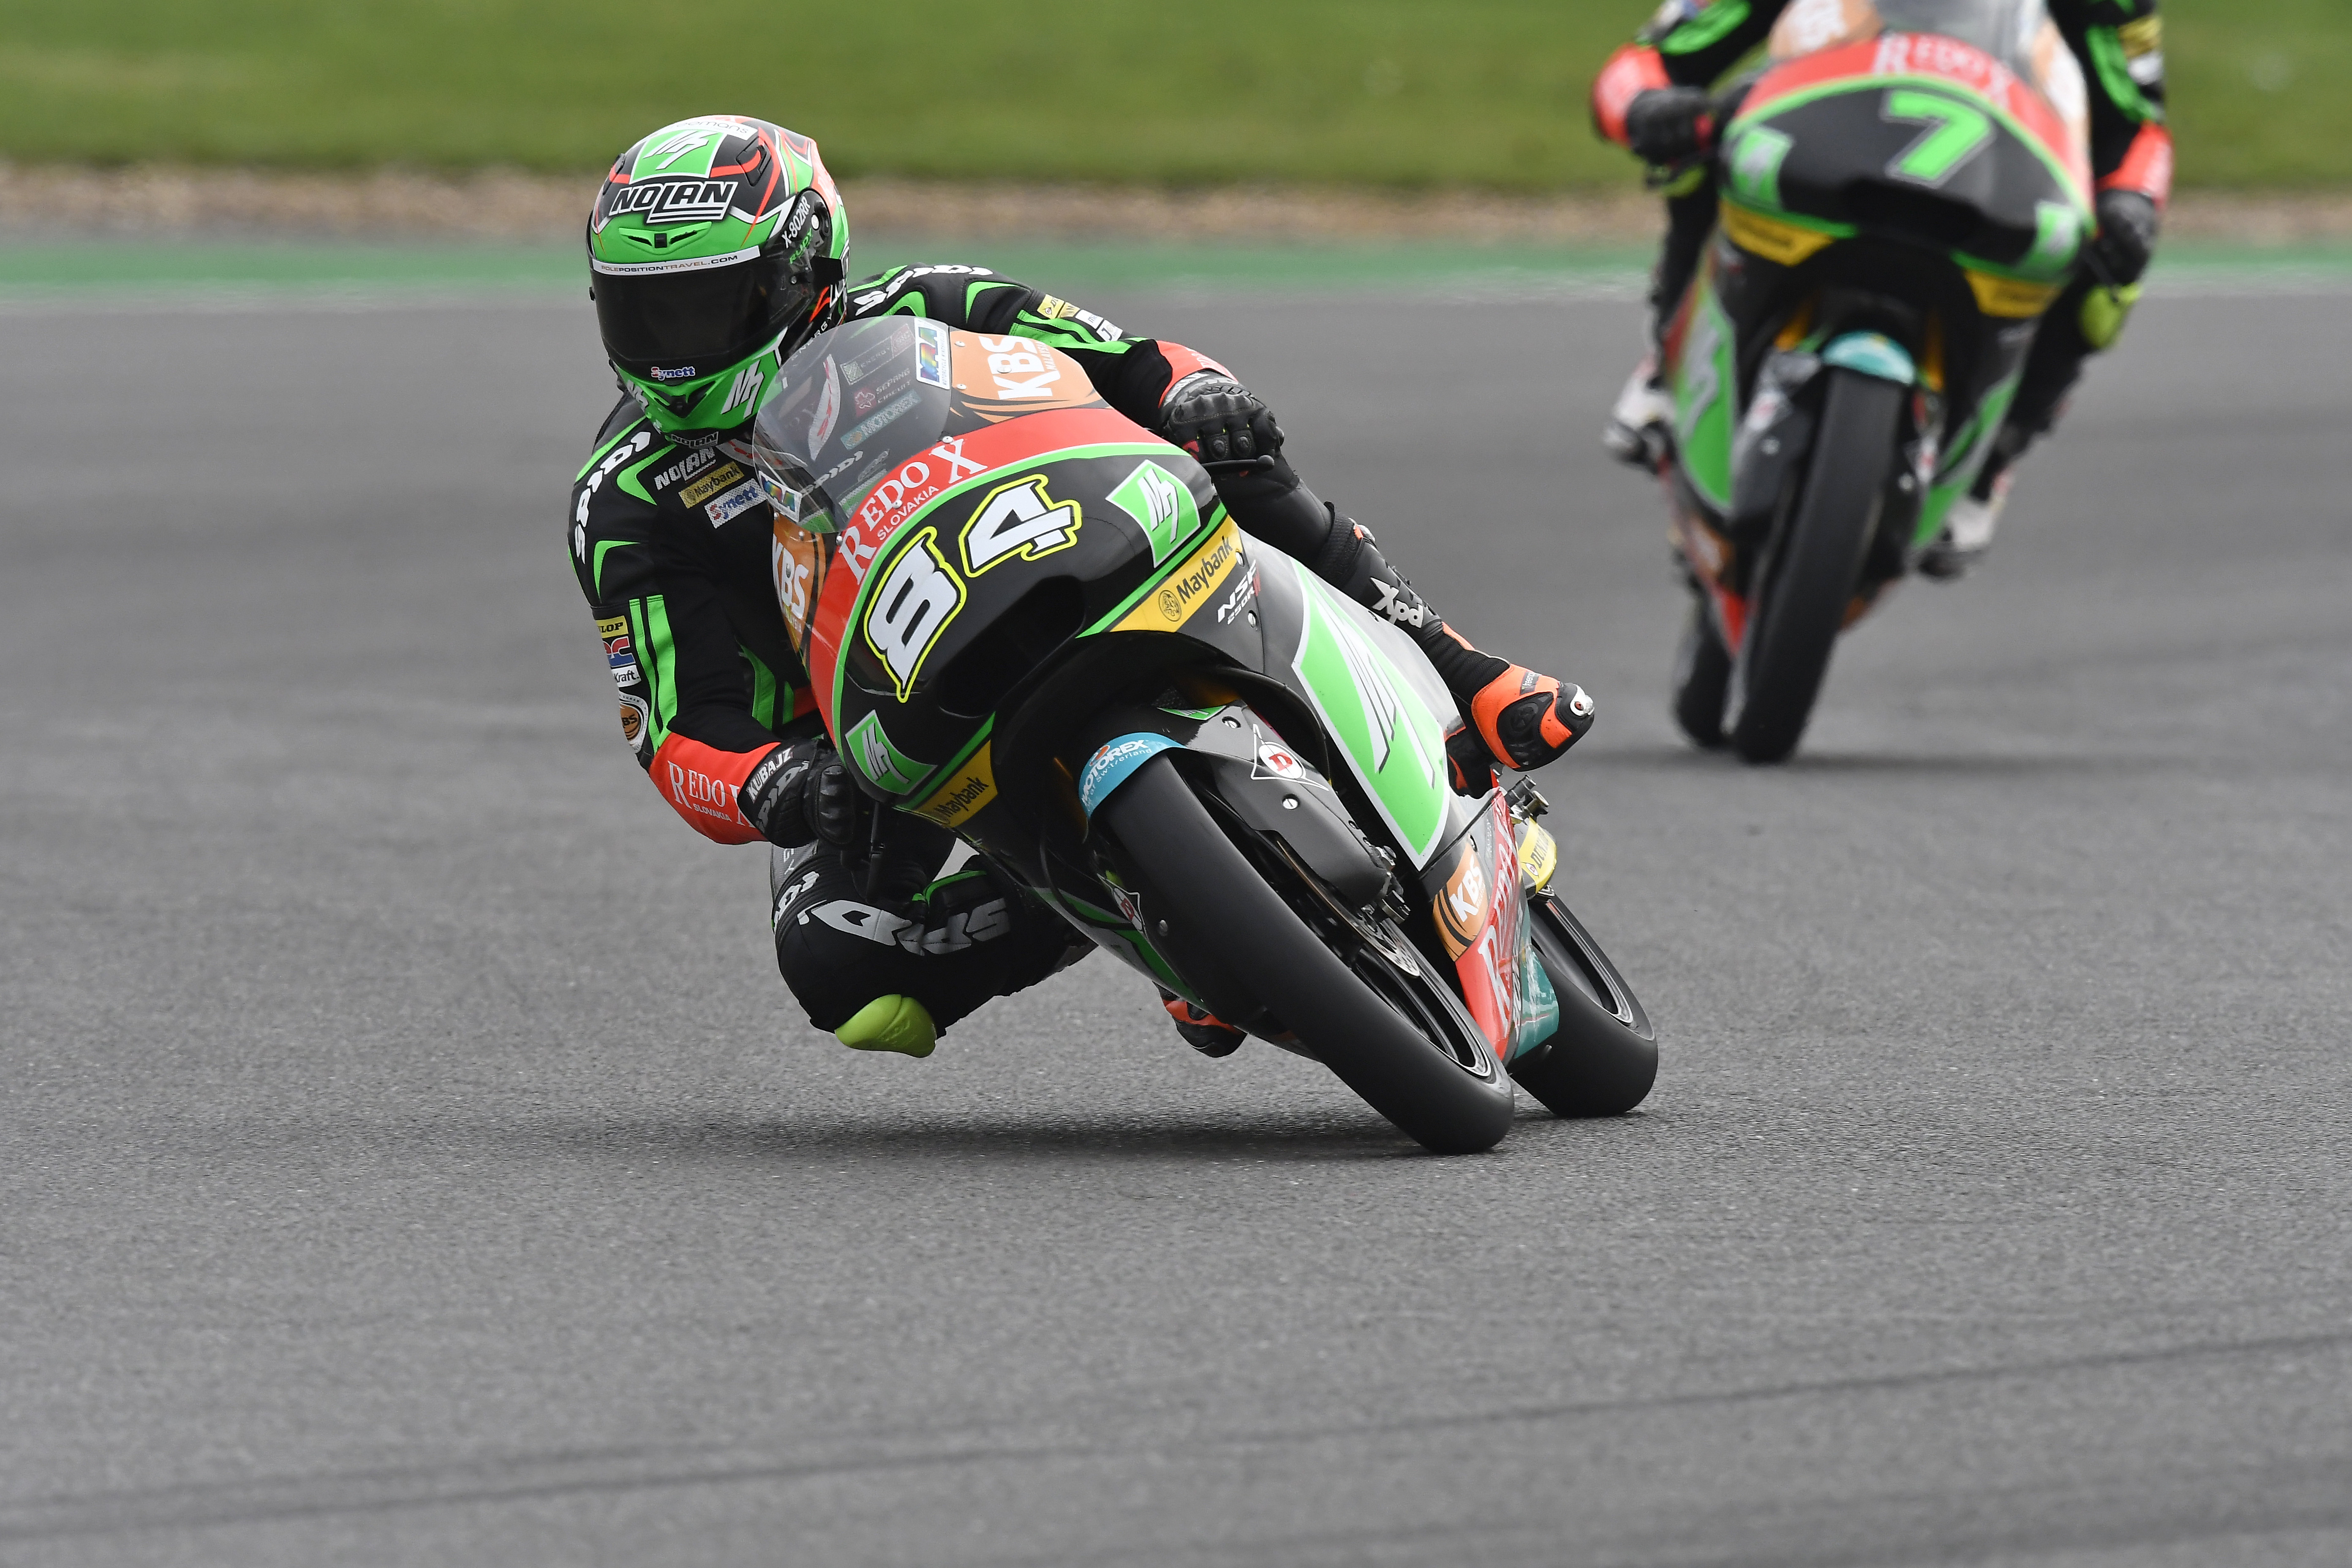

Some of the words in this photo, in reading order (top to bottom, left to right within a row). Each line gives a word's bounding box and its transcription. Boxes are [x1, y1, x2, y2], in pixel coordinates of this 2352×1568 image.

[1887, 90, 1990, 182] 7
[609, 182, 738, 223] NOLAN
[782, 196, 811, 249] X-802RR
[602, 255, 738, 272] POLEPOSITIONTRAVEL.COM
[651, 366, 695, 381] Synett
[979, 336, 1061, 400] KBS
[671, 431, 719, 448] NOLAN
[653, 446, 716, 490] NOLAN
[694, 466, 740, 498] Maybank
[709, 485, 759, 521] Synett
[877, 485, 939, 541] SLOVAKIA
[772, 534, 808, 620] KBS
[866, 478, 1075, 694] 84
[1176, 535, 1233, 604] Maybank
[1218, 559, 1256, 623] NSF
[747, 746, 794, 802] KUBAJZ
[1081, 739, 1149, 803] MOTOREX
[1268, 752, 1293, 772] D
[693, 803, 732, 822] SLOVAKIA
[934, 776, 989, 818] Maybank
[1449, 853, 1483, 923] KBS
